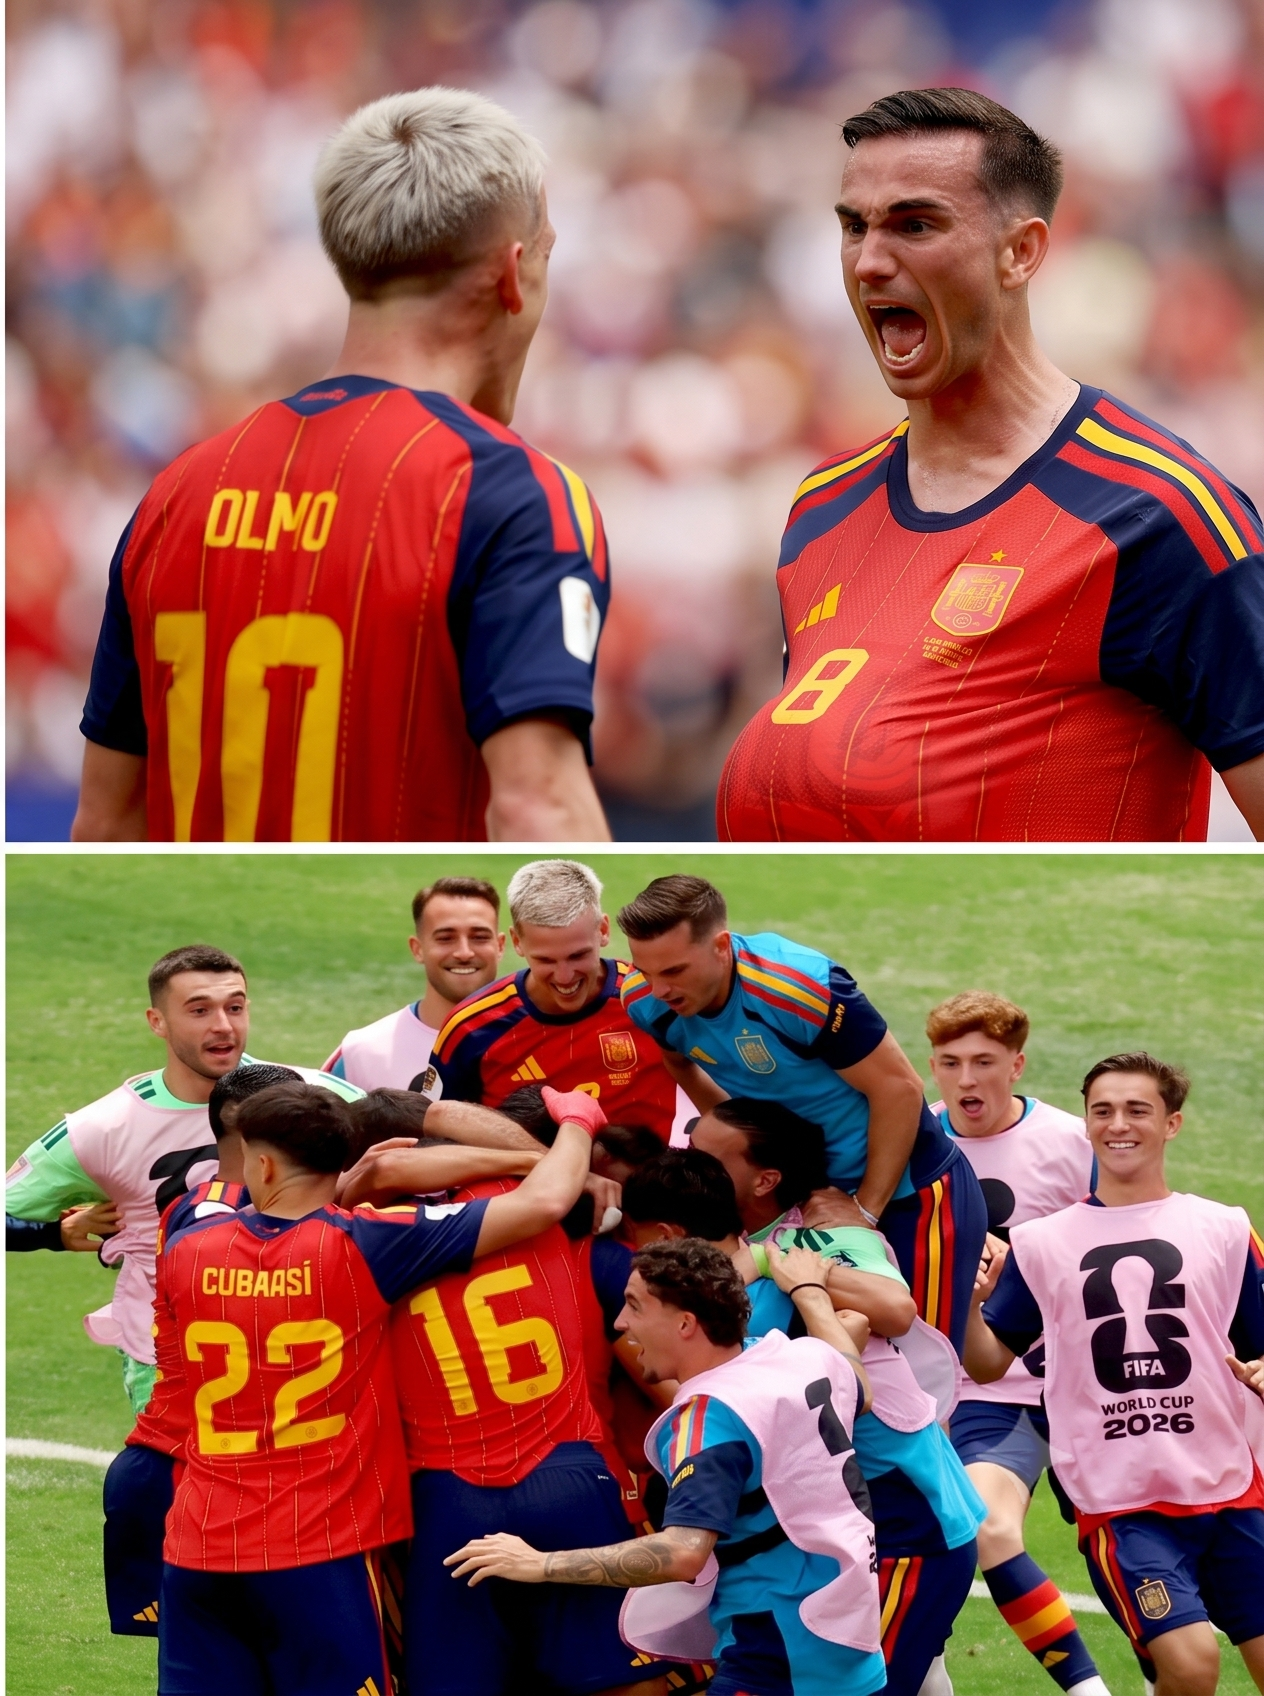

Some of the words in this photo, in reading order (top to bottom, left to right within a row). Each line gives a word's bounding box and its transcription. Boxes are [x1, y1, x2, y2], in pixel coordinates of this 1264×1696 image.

[204, 488, 338, 552] OLMO
[770, 647, 870, 725] 8
[153, 609, 345, 843] 10
[202, 1260, 312, 1298] CUBAASÍ
[410, 1263, 565, 1417] 16
[1123, 1358, 1166, 1379] FIFA
[184, 1319, 346, 1456] 22
[1101, 1396, 1157, 1416] WORLD
[1159, 1395, 1194, 1409] CUP
[1102, 1412, 1195, 1440] 2026
